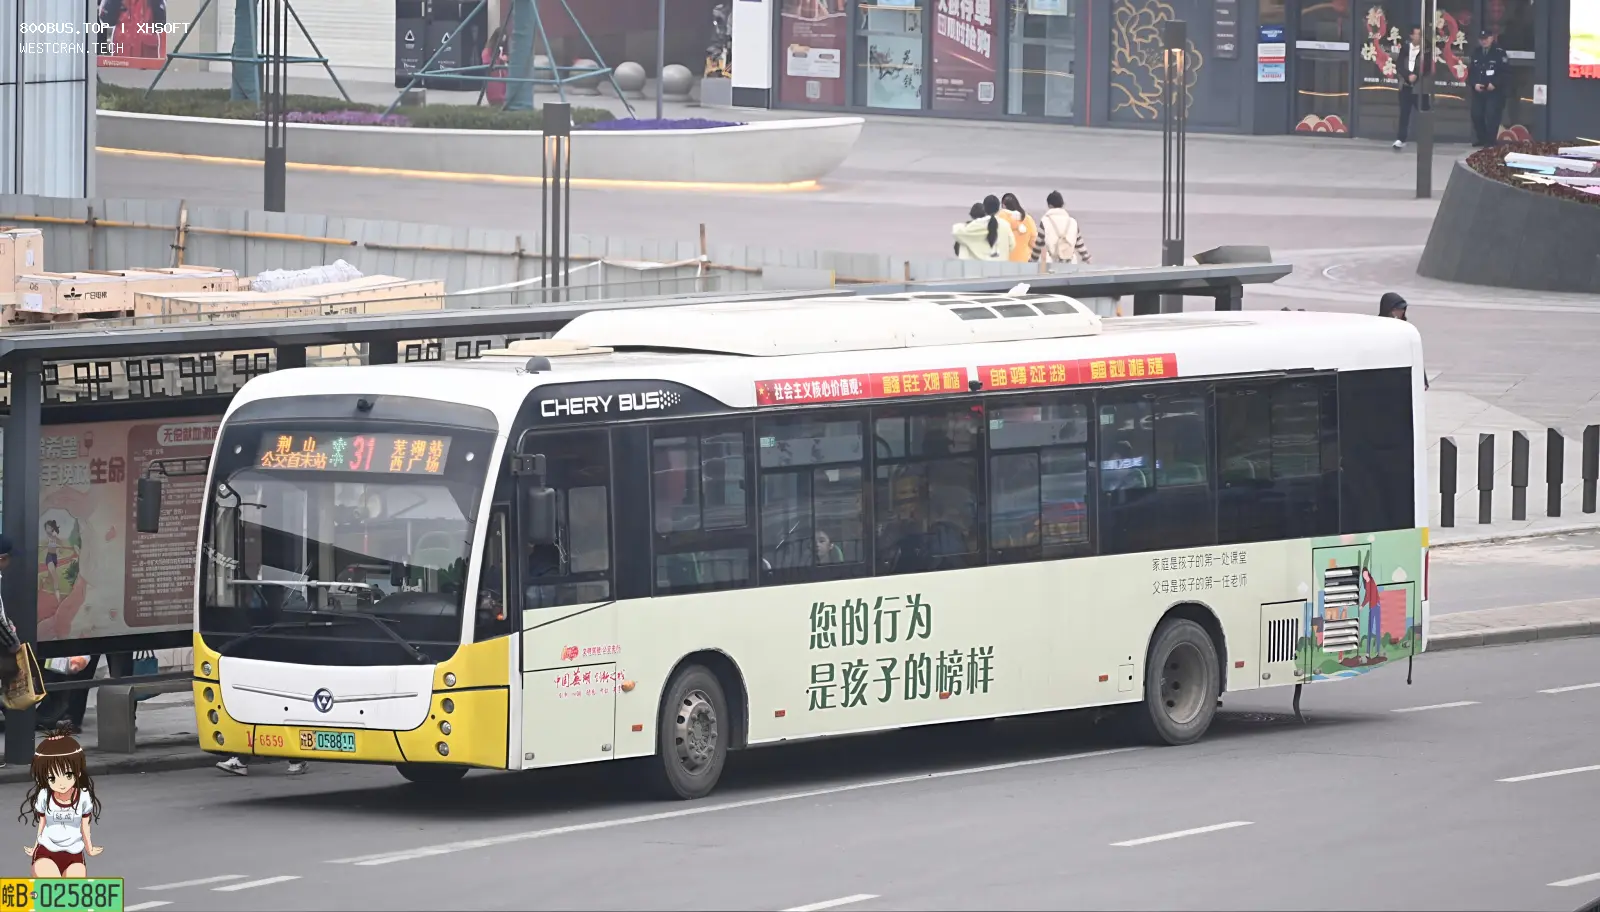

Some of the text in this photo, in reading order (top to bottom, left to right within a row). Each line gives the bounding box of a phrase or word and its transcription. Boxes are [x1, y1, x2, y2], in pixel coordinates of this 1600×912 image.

[103, 59, 129, 67] Welcome
[541, 391, 660, 417] CHERY BUS
[261, 452, 328, 469] 公交首末站
[350, 435, 376, 470] 31
[389, 454, 442, 472] 西广场
[1152, 551, 1247, 571] 家庭是孩子的第一处课堂
[1152, 573, 1247, 595] 父母是孩子的第一任老师
[809, 593, 932, 650] 您的行为
[808, 646, 994, 711] 是孩子的榜样
